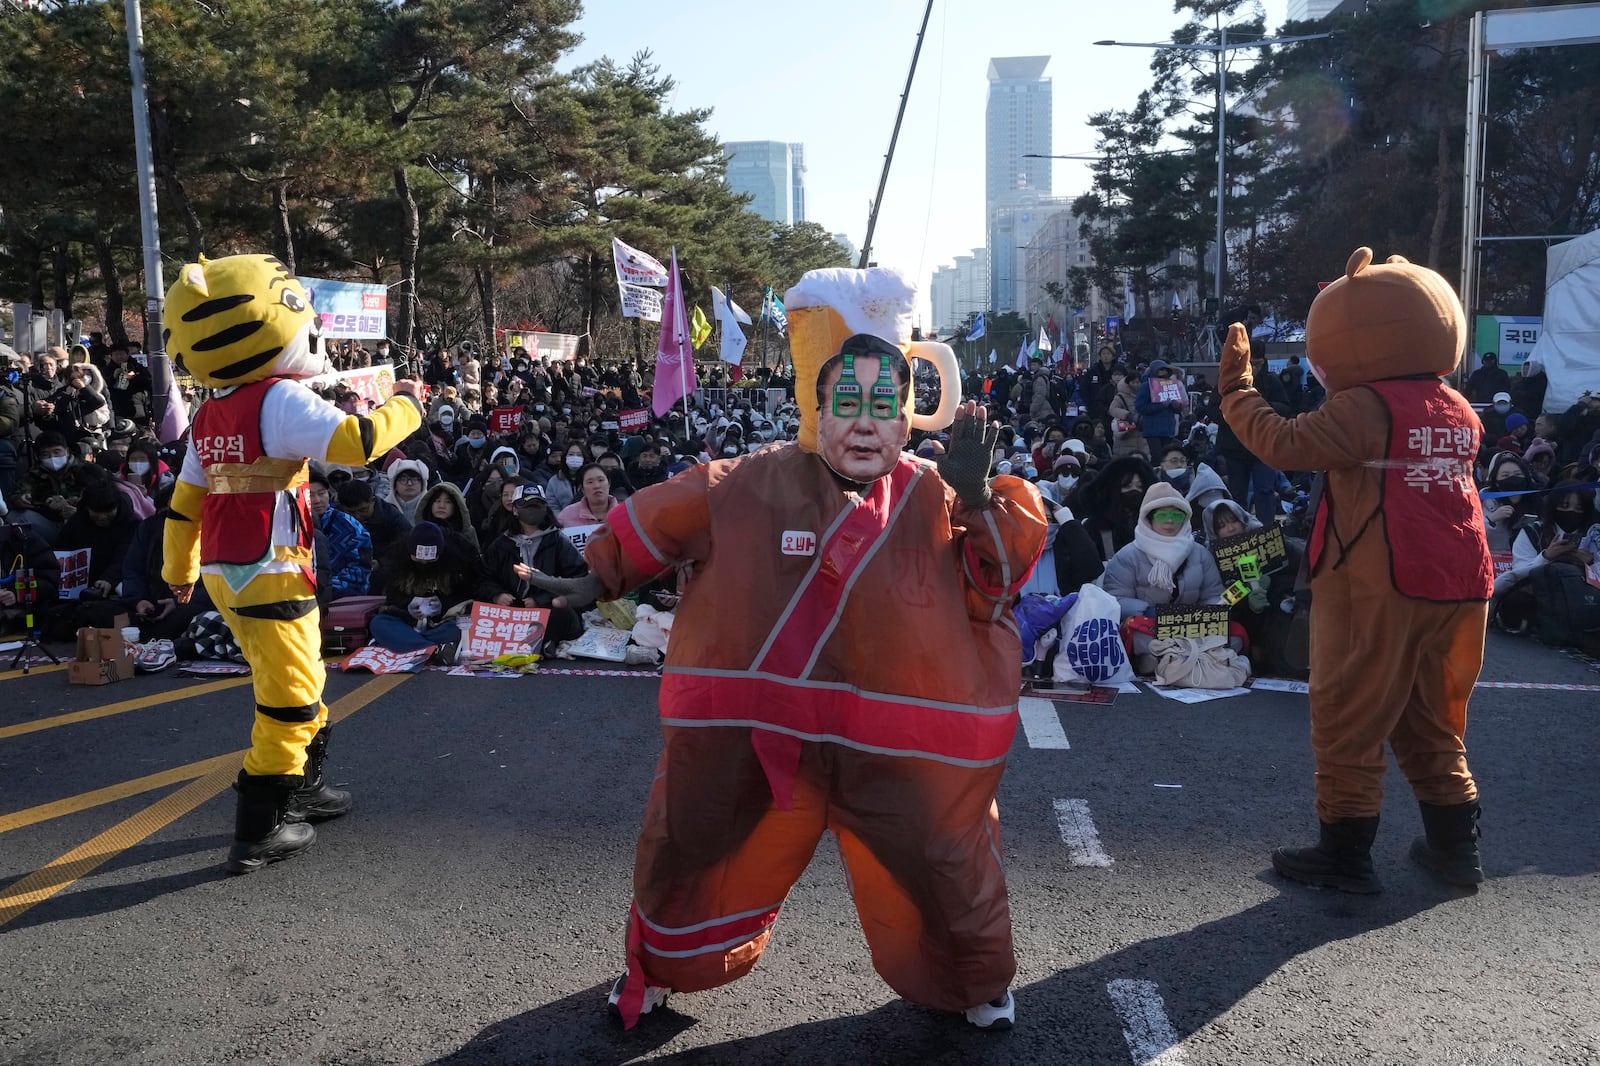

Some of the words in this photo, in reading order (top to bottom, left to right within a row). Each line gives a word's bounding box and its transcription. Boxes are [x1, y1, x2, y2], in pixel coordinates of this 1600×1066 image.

[1202, 610, 1229, 623] 윤석열
[475, 618, 531, 641] 윤석열
[471, 638, 503, 660] 탄핵
